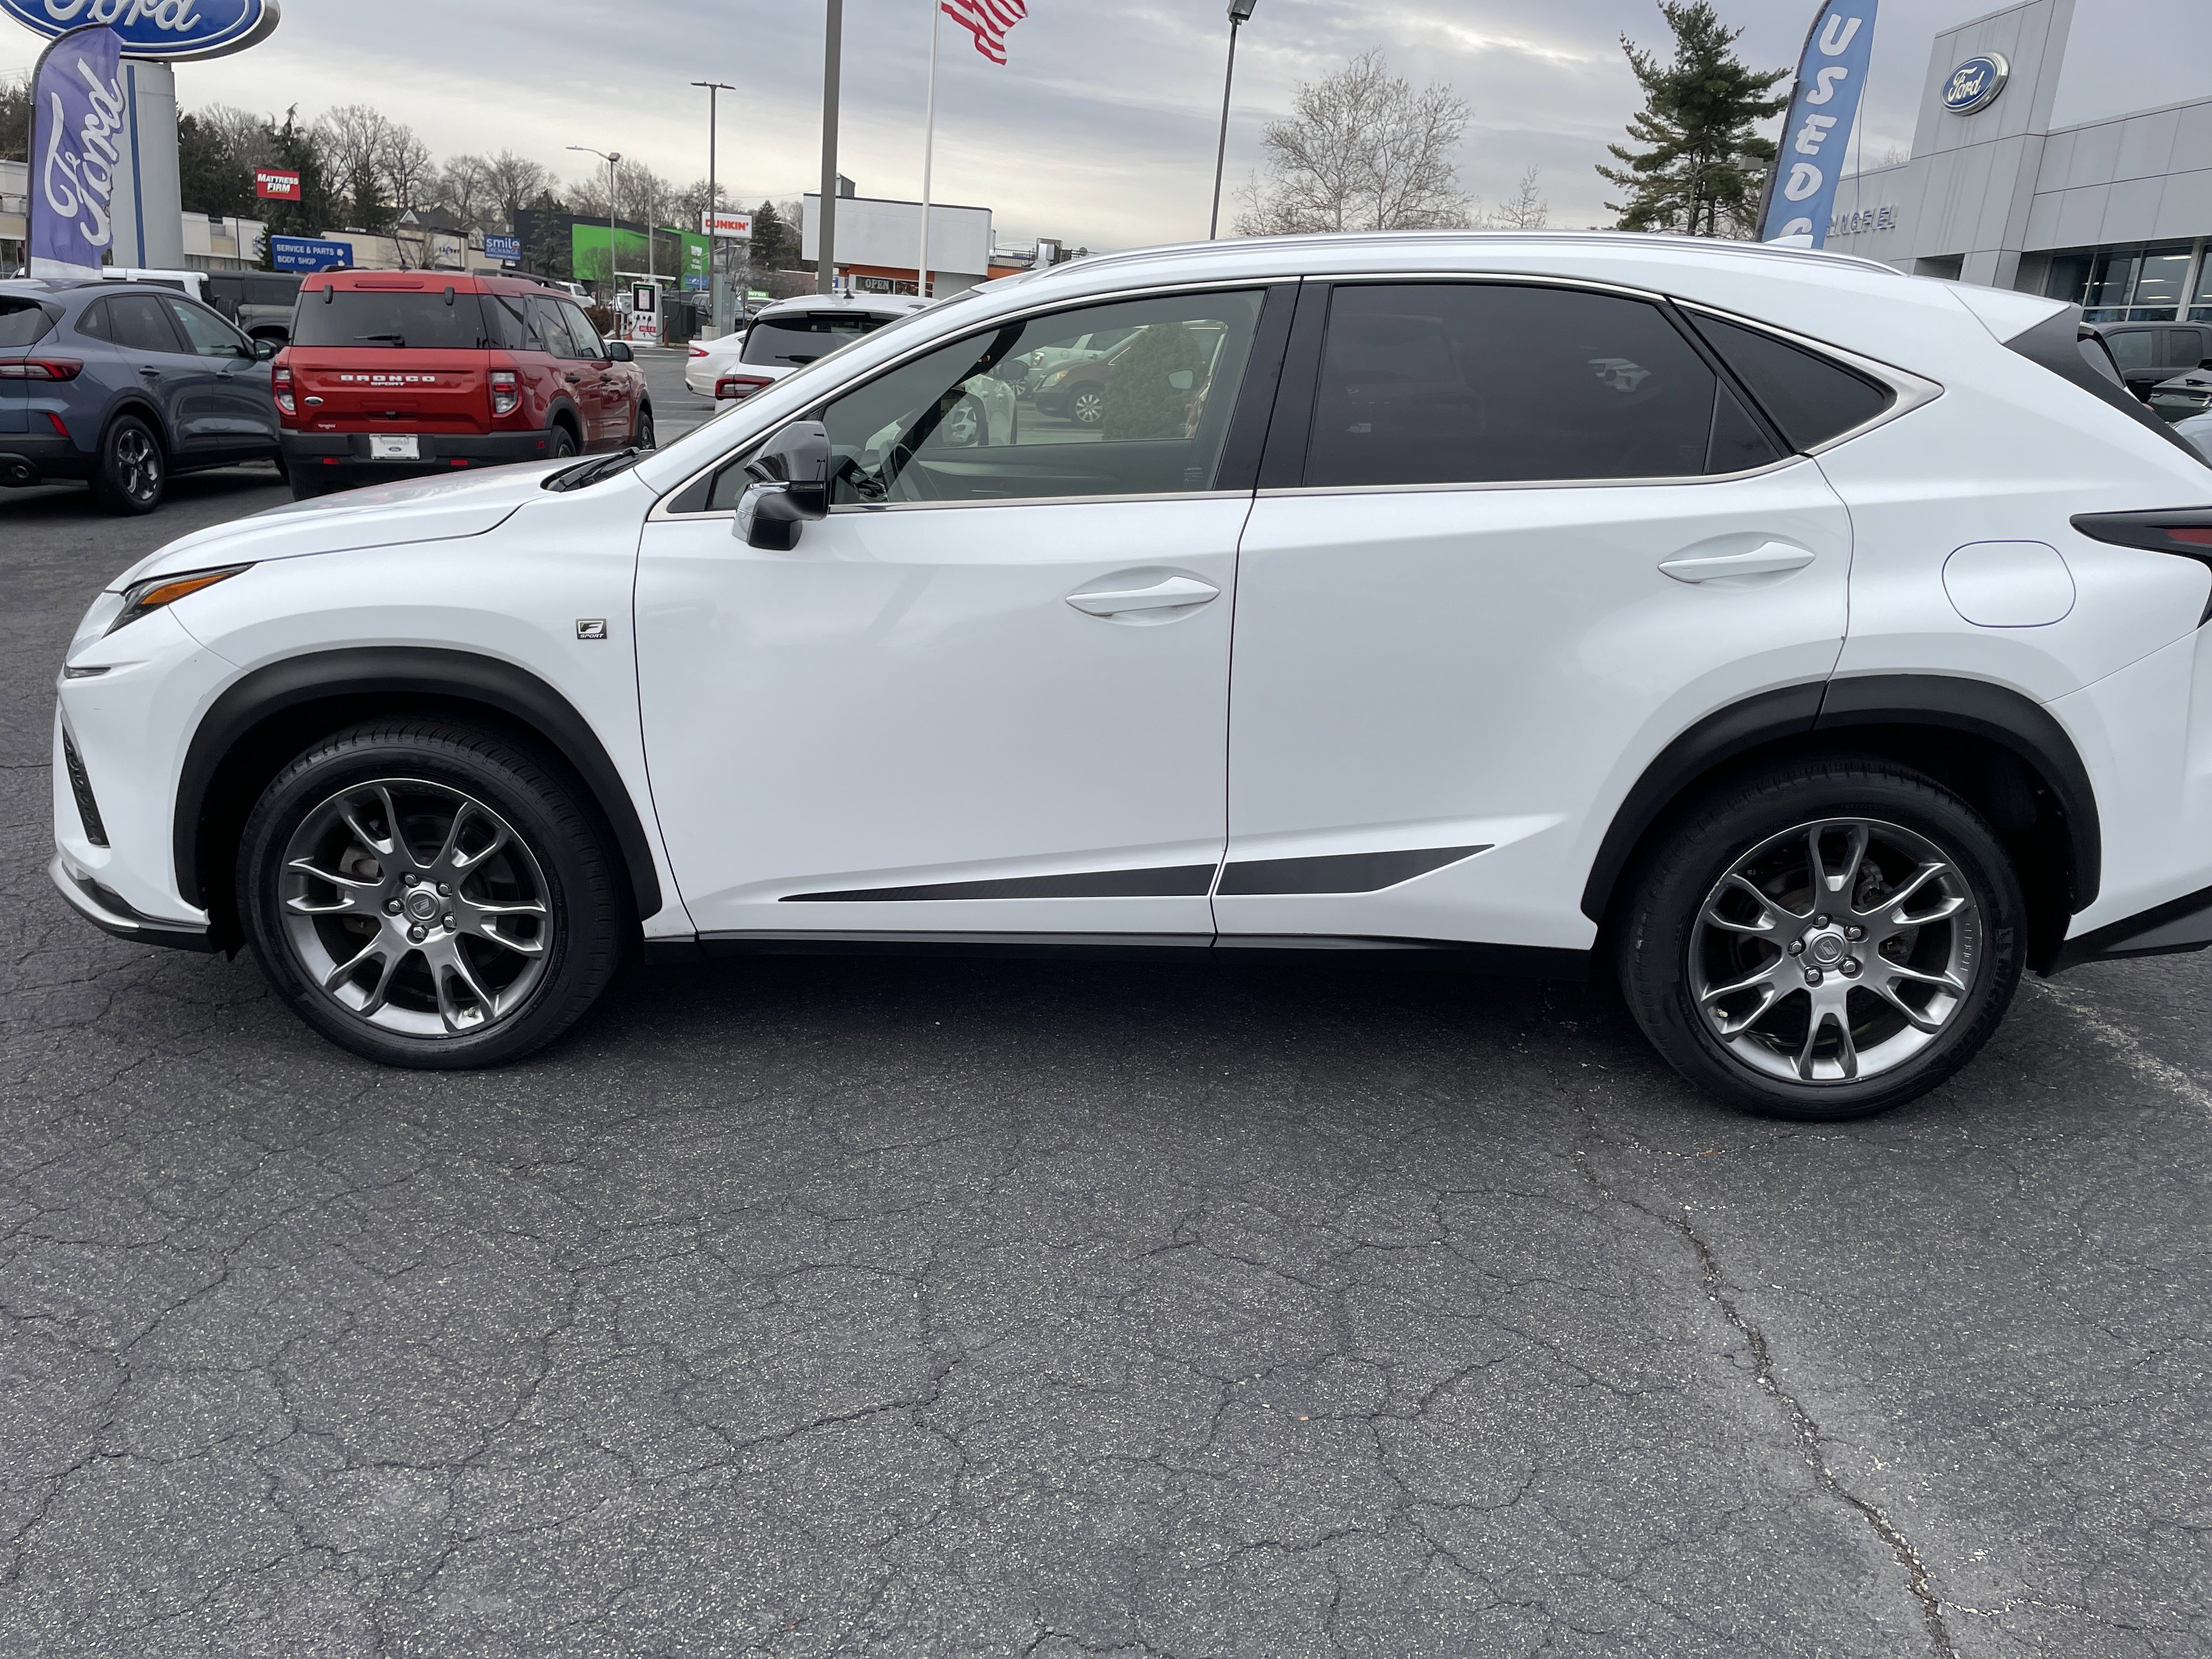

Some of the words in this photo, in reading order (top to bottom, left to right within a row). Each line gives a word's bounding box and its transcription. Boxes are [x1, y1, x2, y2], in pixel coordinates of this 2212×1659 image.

[1948, 66, 1985, 103] Ford
[1785, 14, 1863, 202] USED
[44, 57, 124, 246] Ford
[257, 173, 299, 185] MATTRESS
[267, 182, 291, 192] FIRM
[276, 244, 304, 253] SERVICE
[306, 246, 311, 255] &
[313, 247, 334, 256] PARTS
[486, 238, 520, 250] smile
[486, 247, 518, 256] EXCHANGE
[277, 256, 296, 264] BODY
[298, 256, 317, 265] SHOP
[865, 278, 889, 290] OPEN
